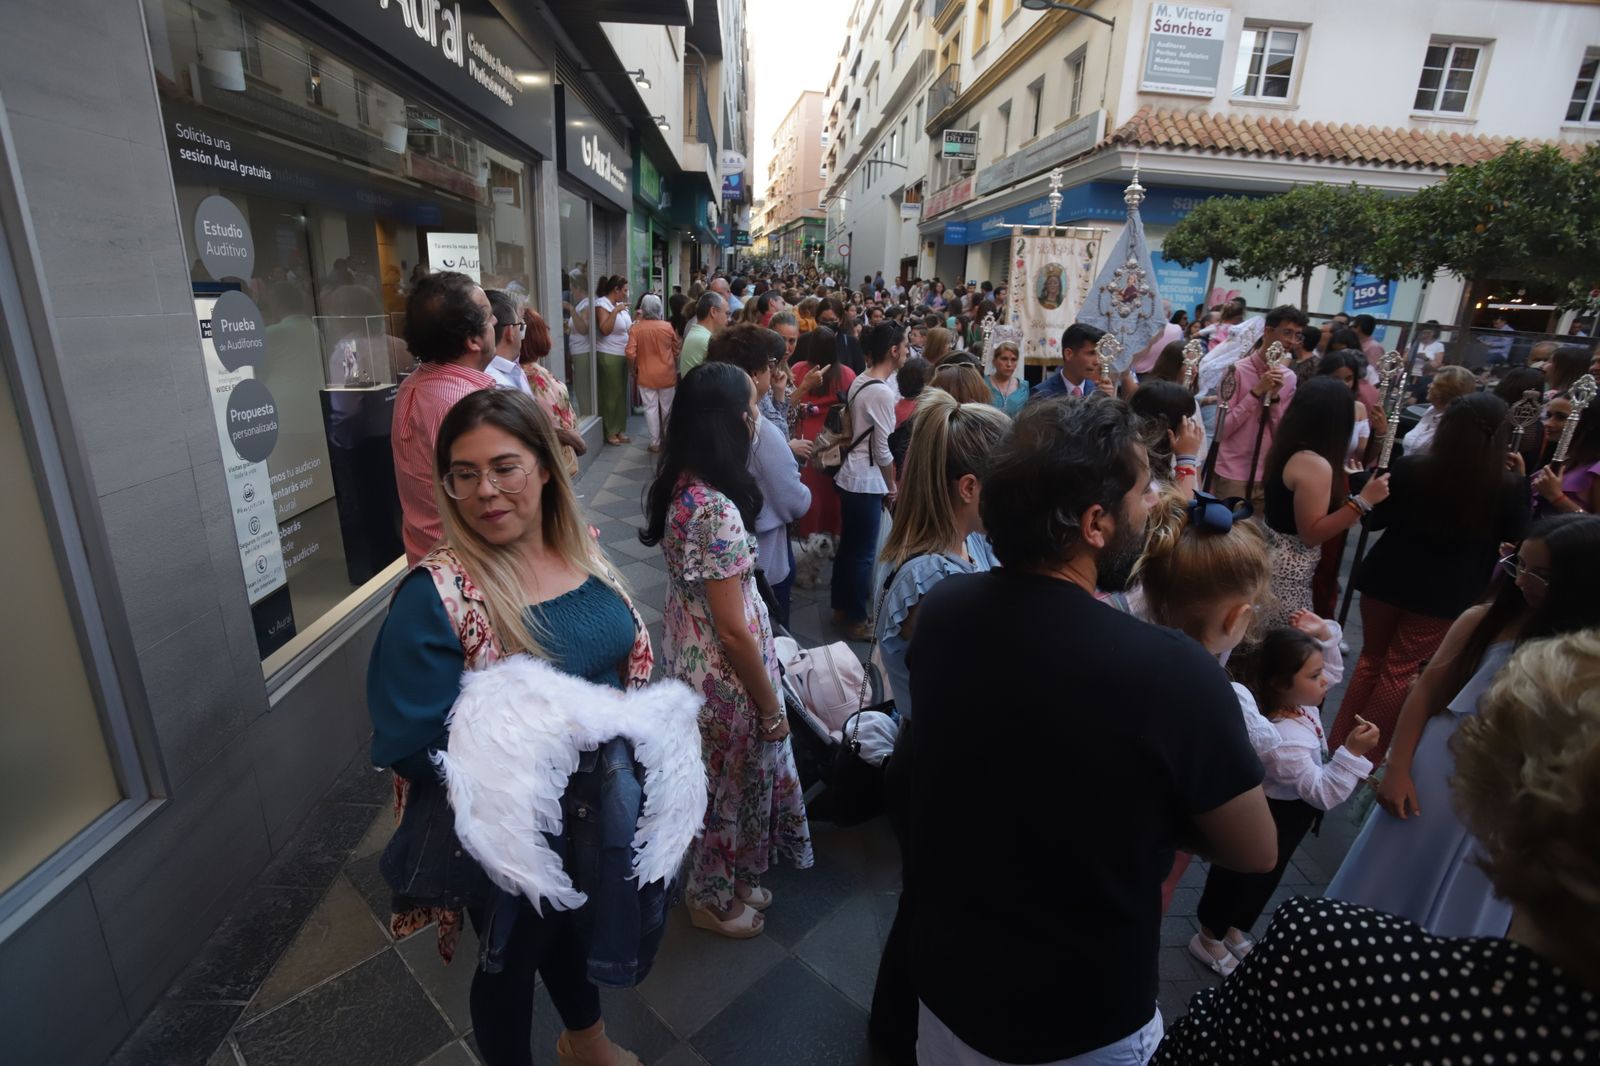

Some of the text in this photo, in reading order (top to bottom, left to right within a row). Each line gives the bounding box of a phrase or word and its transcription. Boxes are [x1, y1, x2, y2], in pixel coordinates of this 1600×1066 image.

[1155, 4, 1224, 23] M. Victoria
[1153, 18, 1213, 37] Sánchez
[175, 122, 232, 151] Solicita una
[180, 148, 272, 180] sesión Aural gratuita
[203, 220, 243, 239] Estudio
[206, 241, 248, 258] Auditivo
[1354, 284, 1387, 300] 150 €
[220, 317, 256, 333] Prueba
[219, 338, 263, 352] de Audífonos
[230, 403, 275, 423] Propuesta
[232, 421, 278, 443] personalizada
[286, 468, 295, 478] tu
[292, 543, 320, 564] audición
